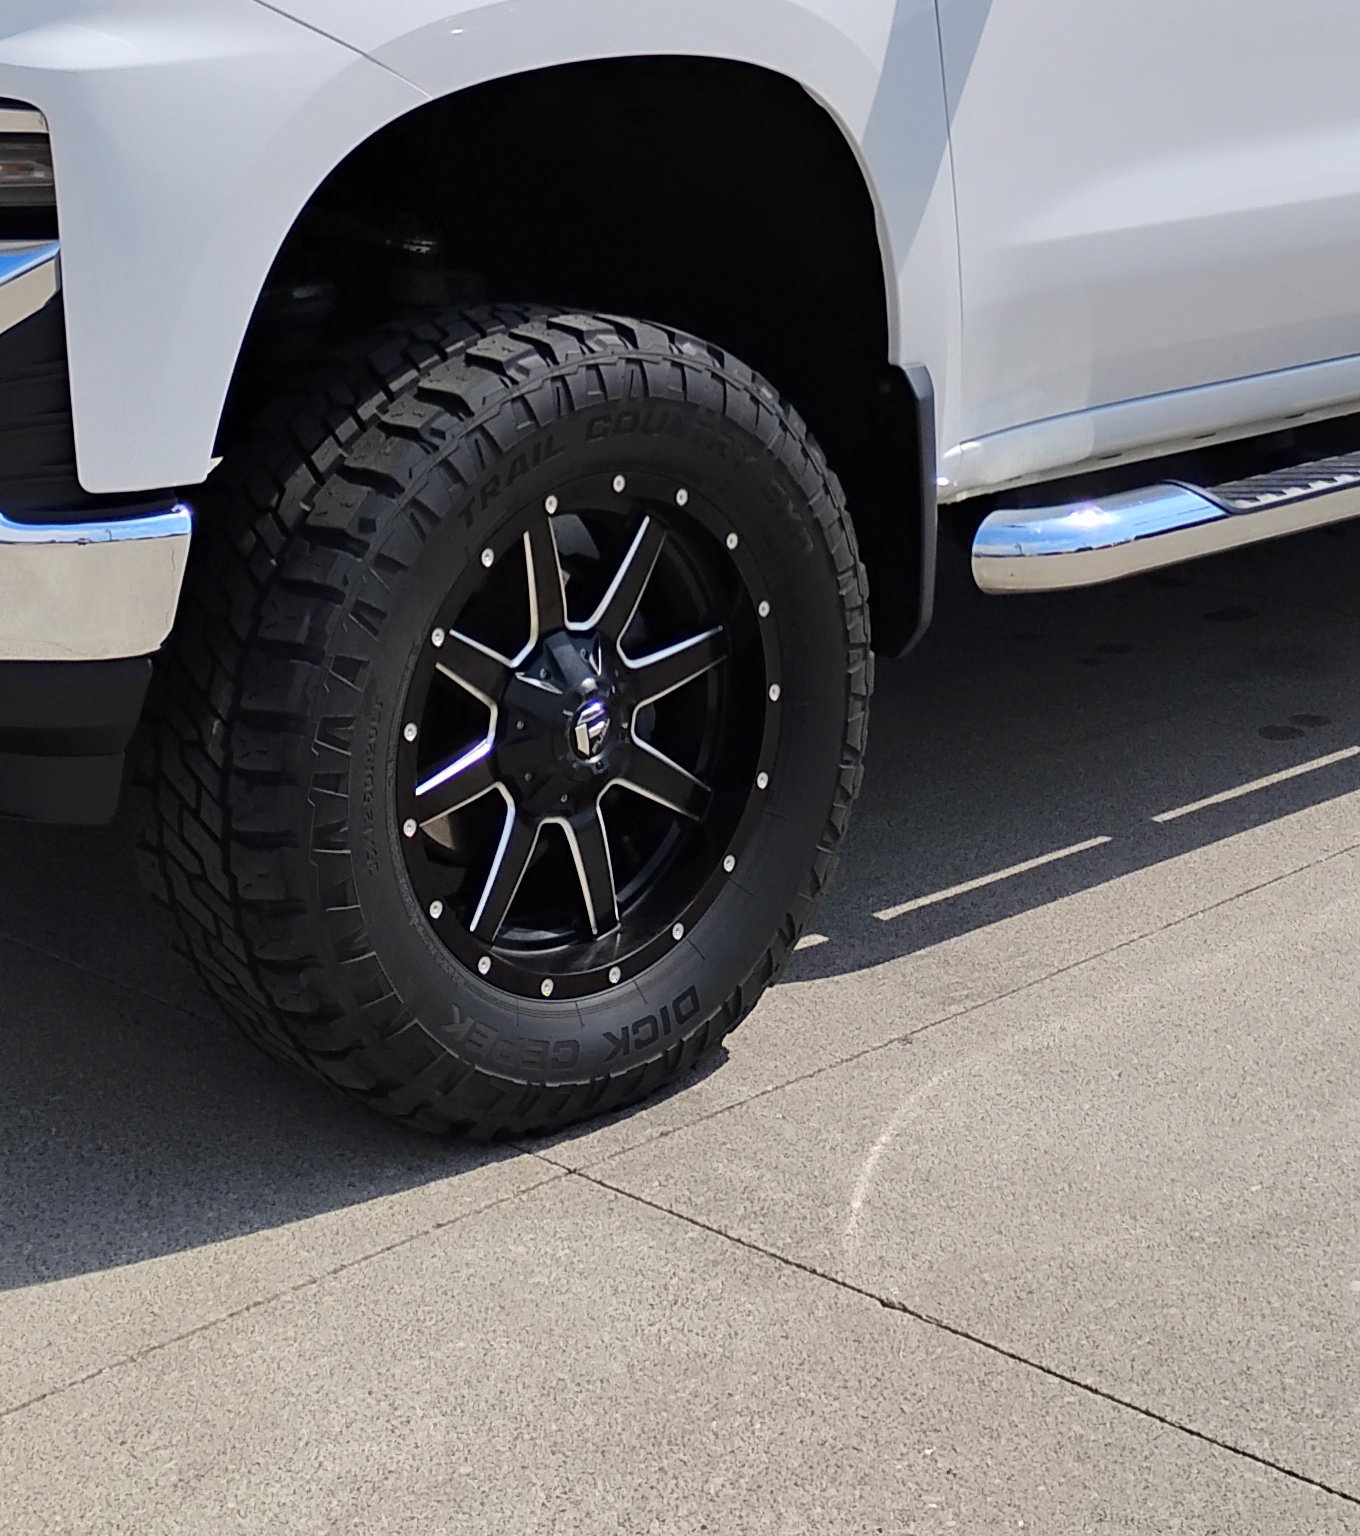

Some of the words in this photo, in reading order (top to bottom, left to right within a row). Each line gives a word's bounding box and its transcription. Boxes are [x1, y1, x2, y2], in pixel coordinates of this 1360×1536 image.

[457, 434, 566, 529] TRAIL
[439, 1002, 582, 1071] CEPEK
[602, 984, 702, 1063] DICK
